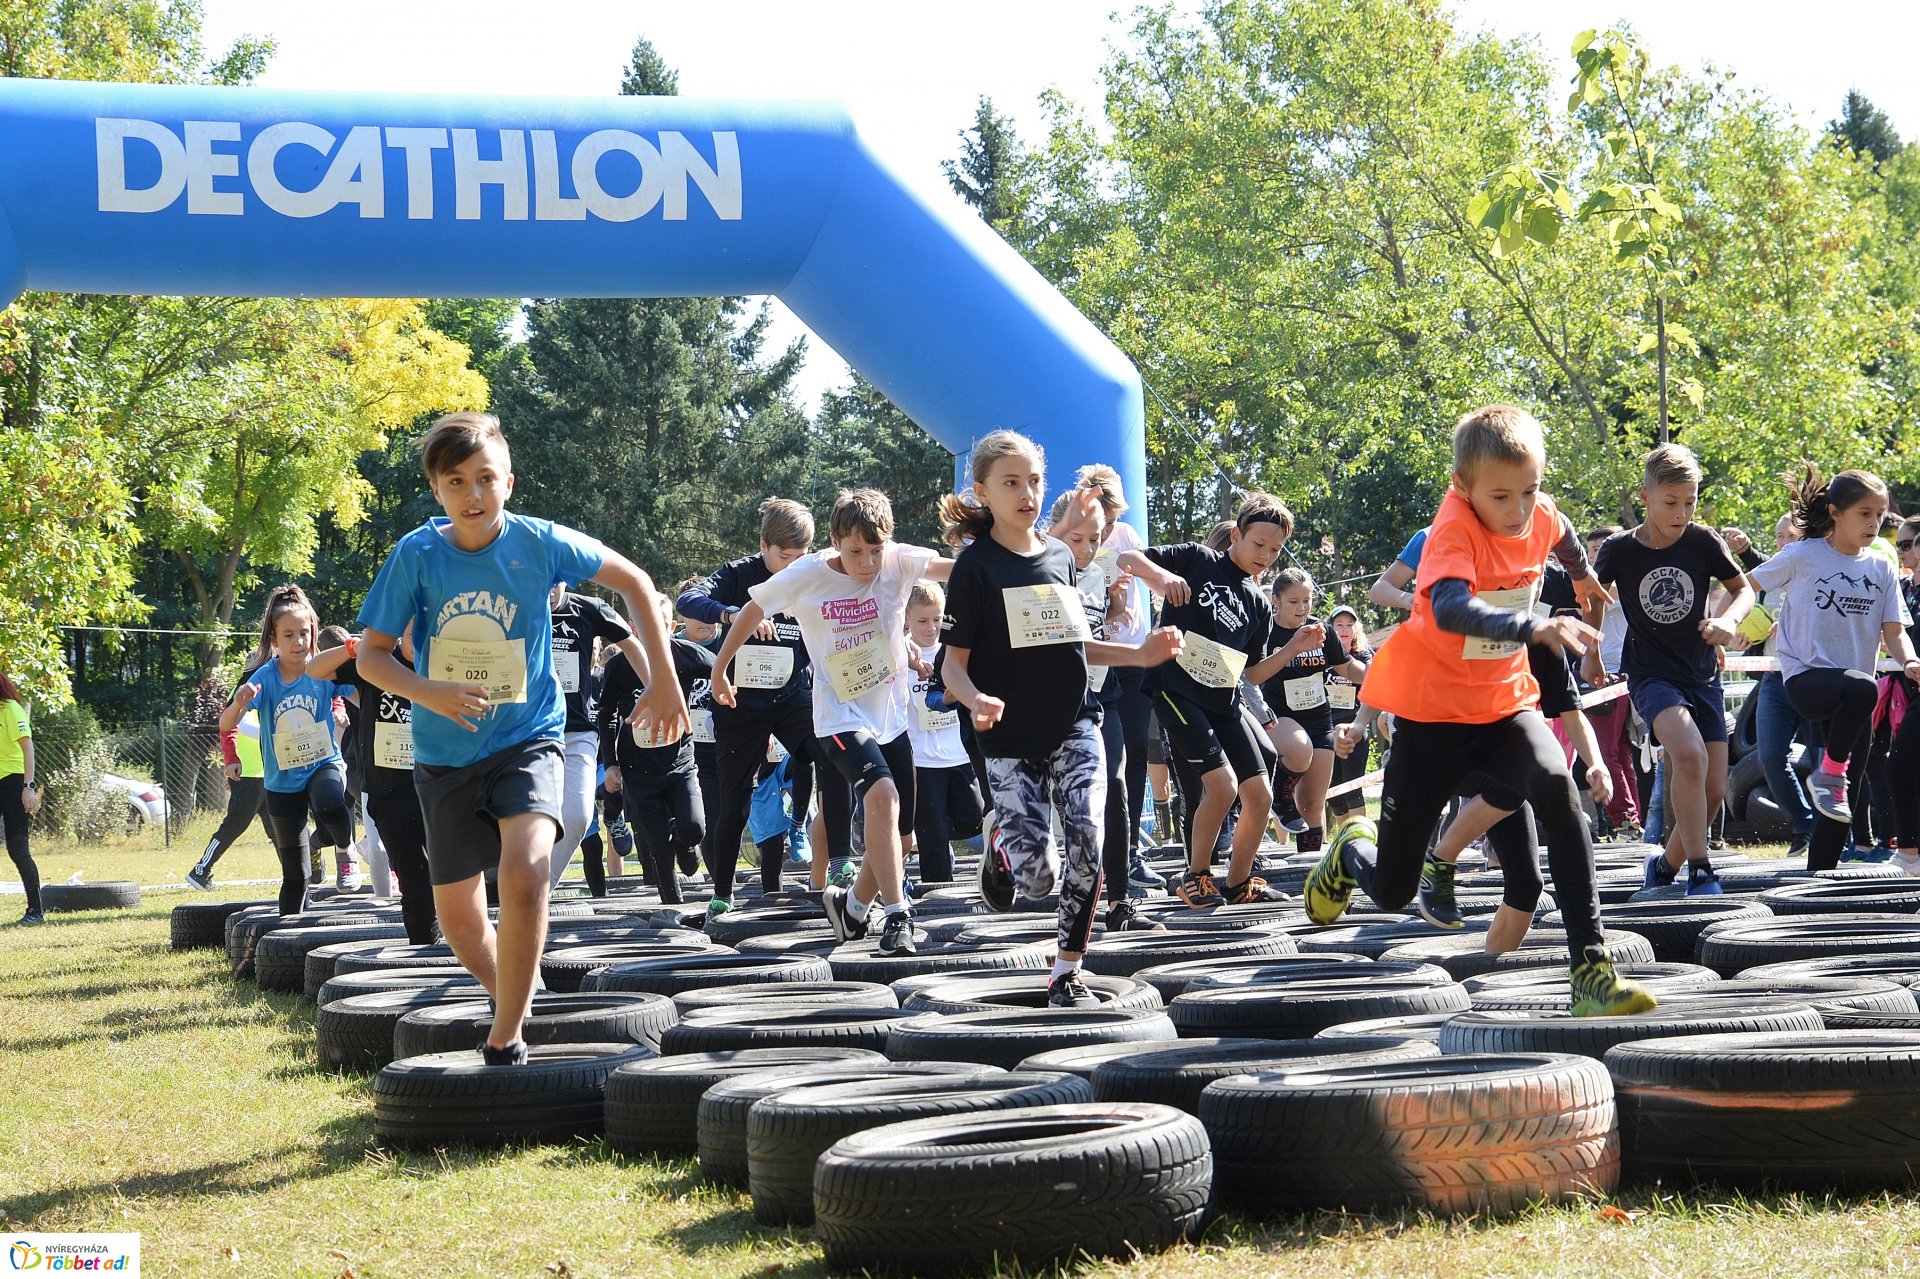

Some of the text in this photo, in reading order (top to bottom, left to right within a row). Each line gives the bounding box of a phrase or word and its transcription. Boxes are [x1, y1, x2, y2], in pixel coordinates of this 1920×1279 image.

[96, 117, 743, 222] DECATHLON
[1651, 569, 1679, 580] CCM
[1041, 610, 1060, 620] 022
[1643, 599, 1692, 622] SHOWCASE
[835, 630, 875, 650] EGYÜTT
[1202, 659, 1217, 669] 049
[1301, 656, 1326, 668] KIDS
[465, 670, 488, 680] 020
[857, 663, 873, 676] 084
[297, 743, 311, 752] 021
